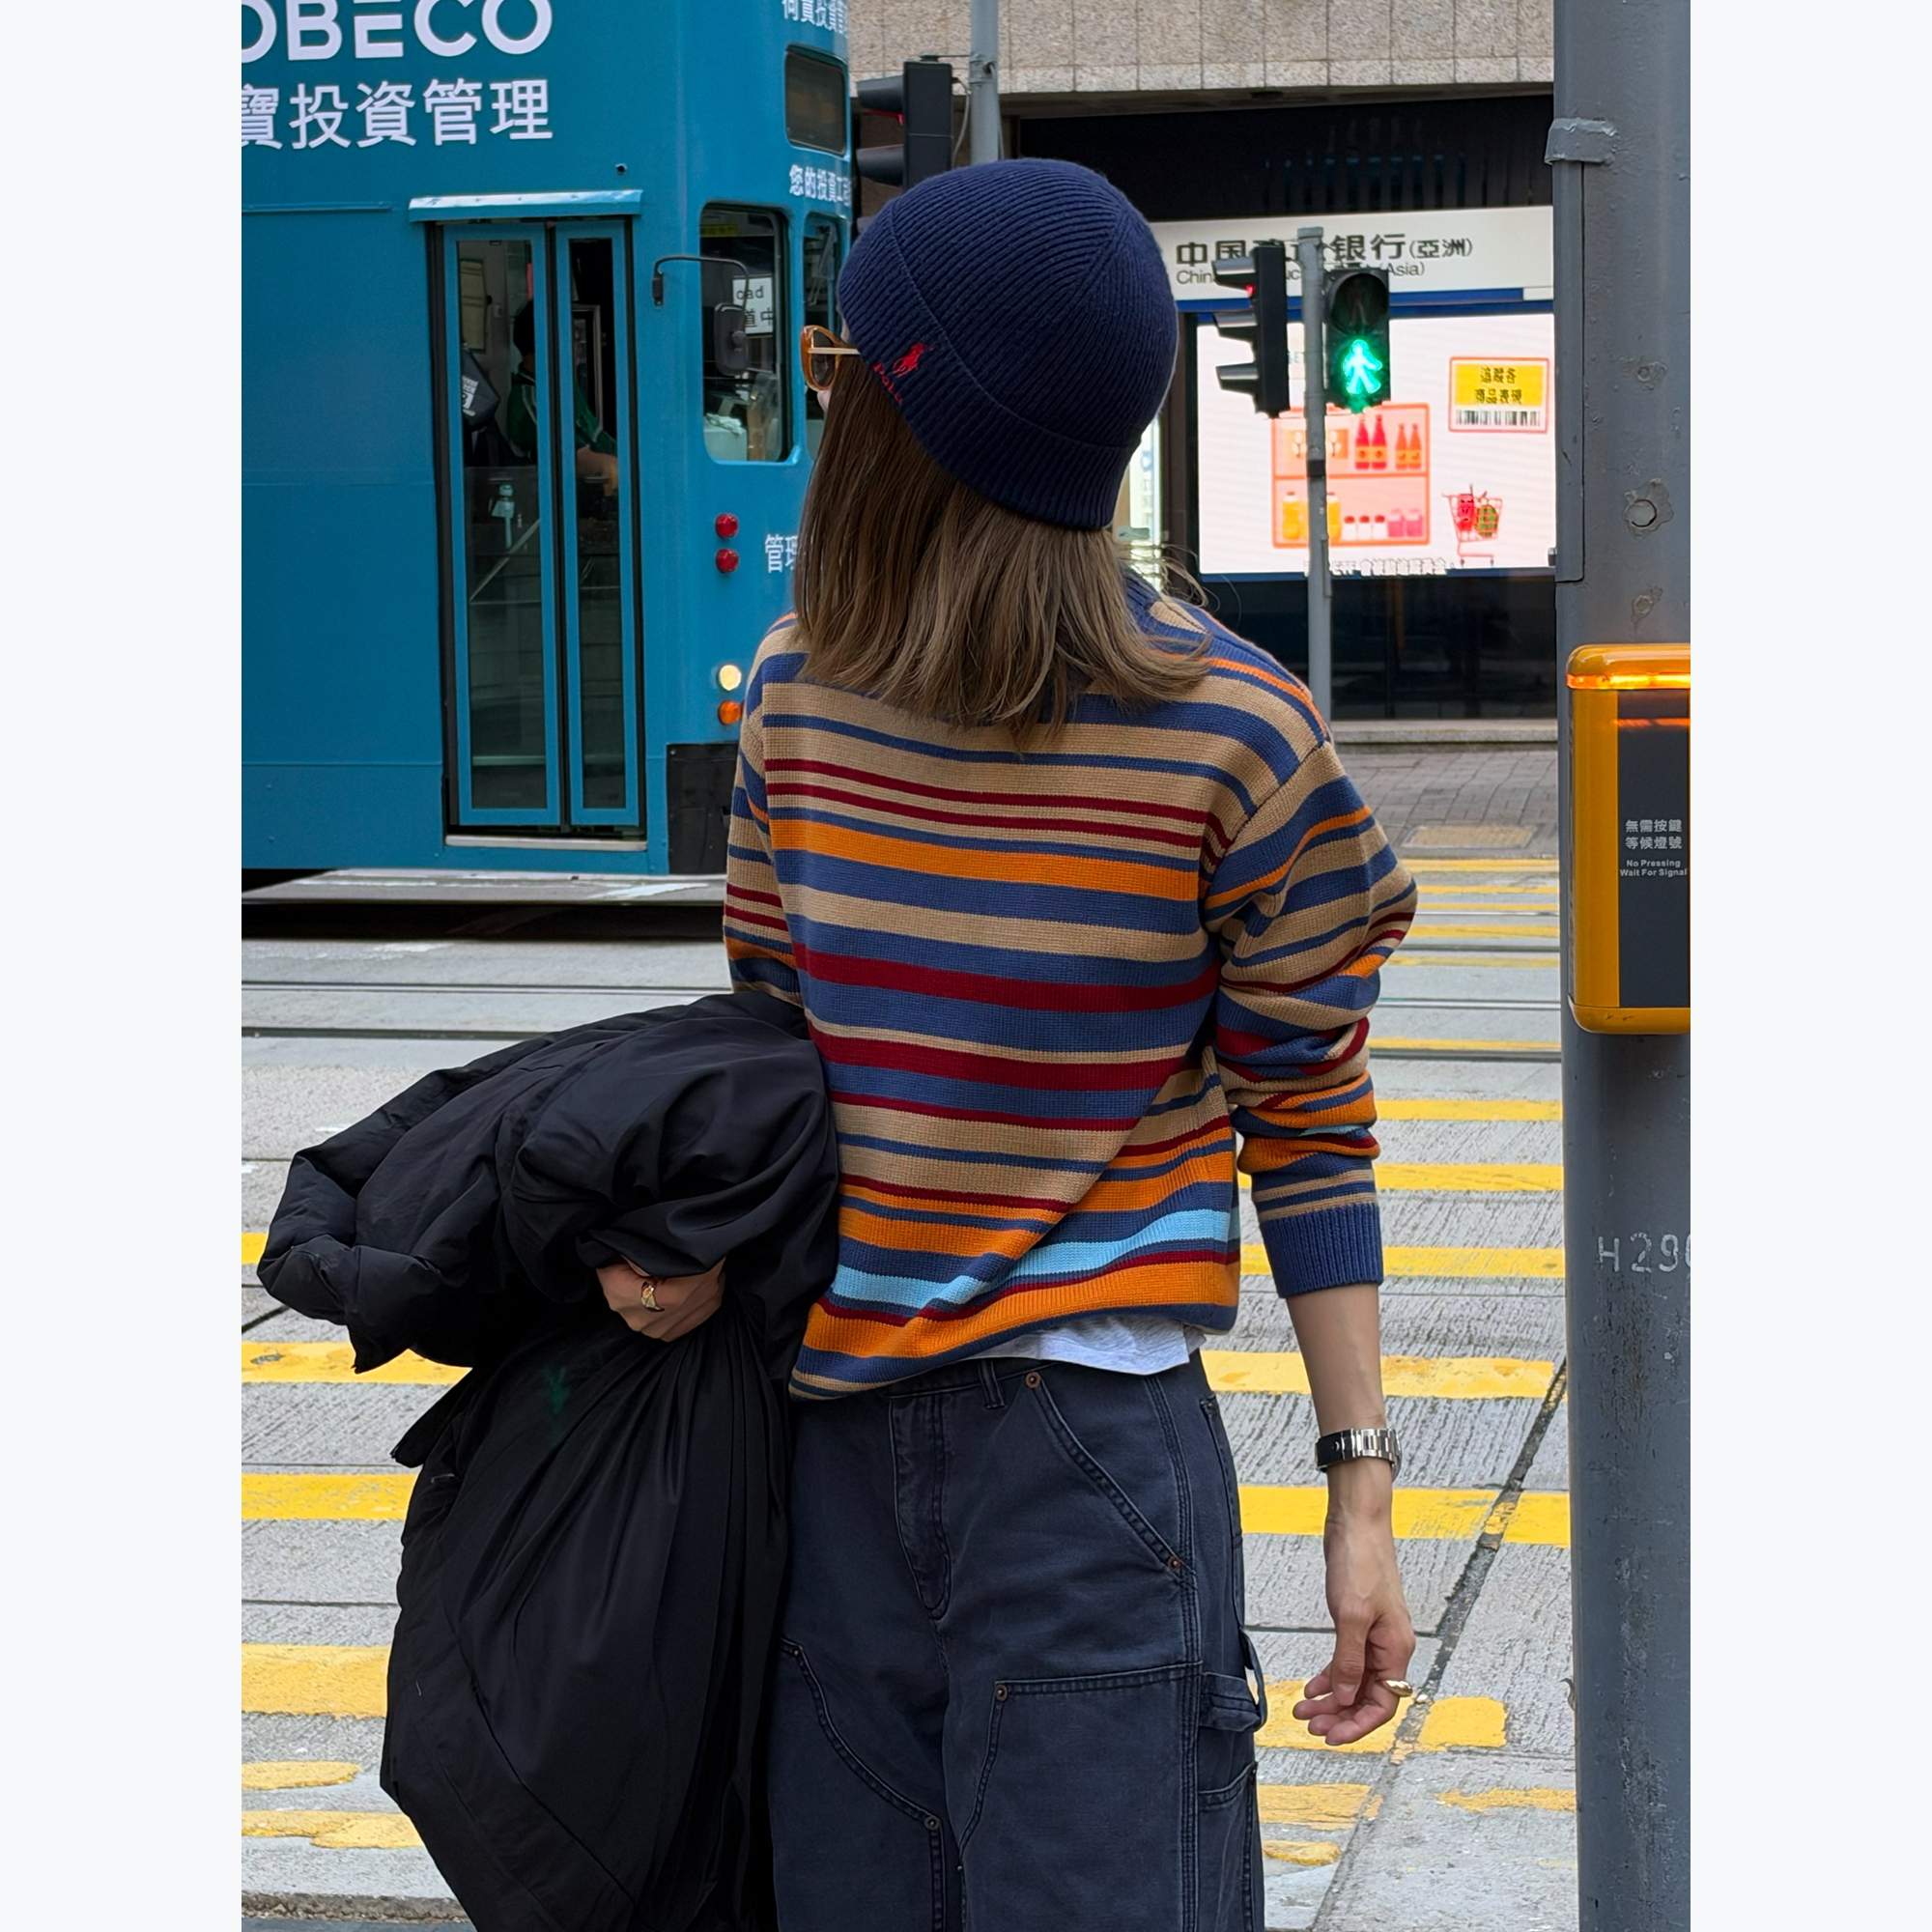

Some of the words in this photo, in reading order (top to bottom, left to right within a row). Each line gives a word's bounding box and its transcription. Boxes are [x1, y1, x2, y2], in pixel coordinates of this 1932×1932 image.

[1176, 233, 1473, 268] 中国银行(亞洲)
[1176, 270, 1215, 285] Chin
[1380, 262, 1425, 277] Asia)
[1625, 837, 1682, 850] 等候燈號
[1640, 859, 1681, 868] Pressing
[1620, 868, 1640, 877] Wait
[1659, 868, 1688, 878] Signal
